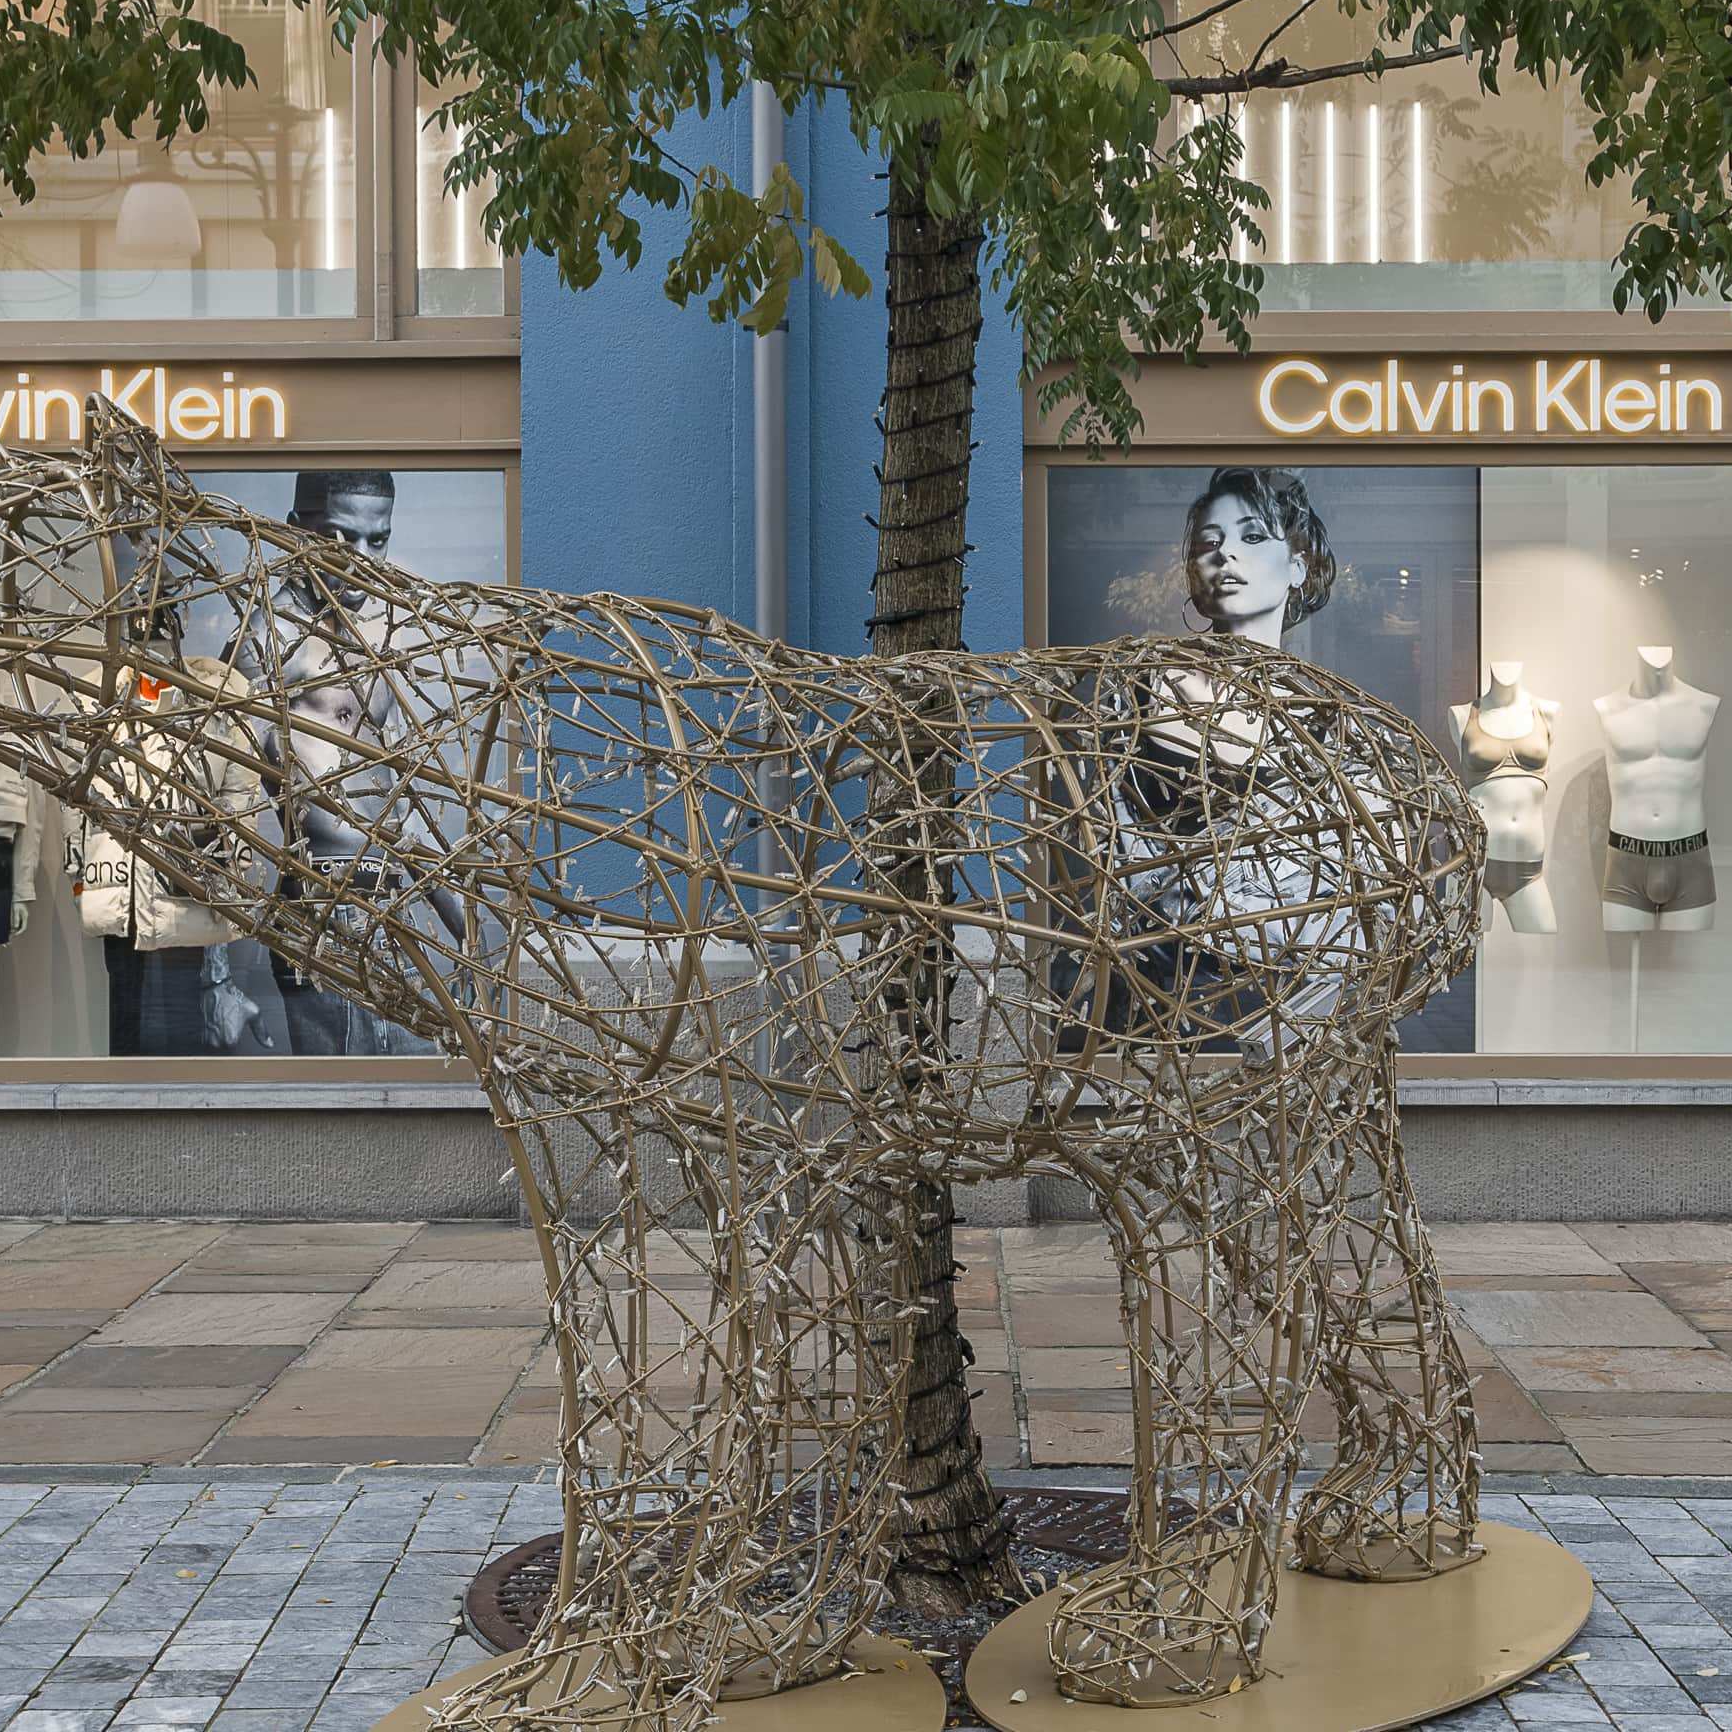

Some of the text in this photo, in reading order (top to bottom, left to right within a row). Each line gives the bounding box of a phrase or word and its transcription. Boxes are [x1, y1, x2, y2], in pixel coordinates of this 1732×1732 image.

[100, 367, 286, 441] Klein
[1259, 359, 1723, 433] Calvin Klein
